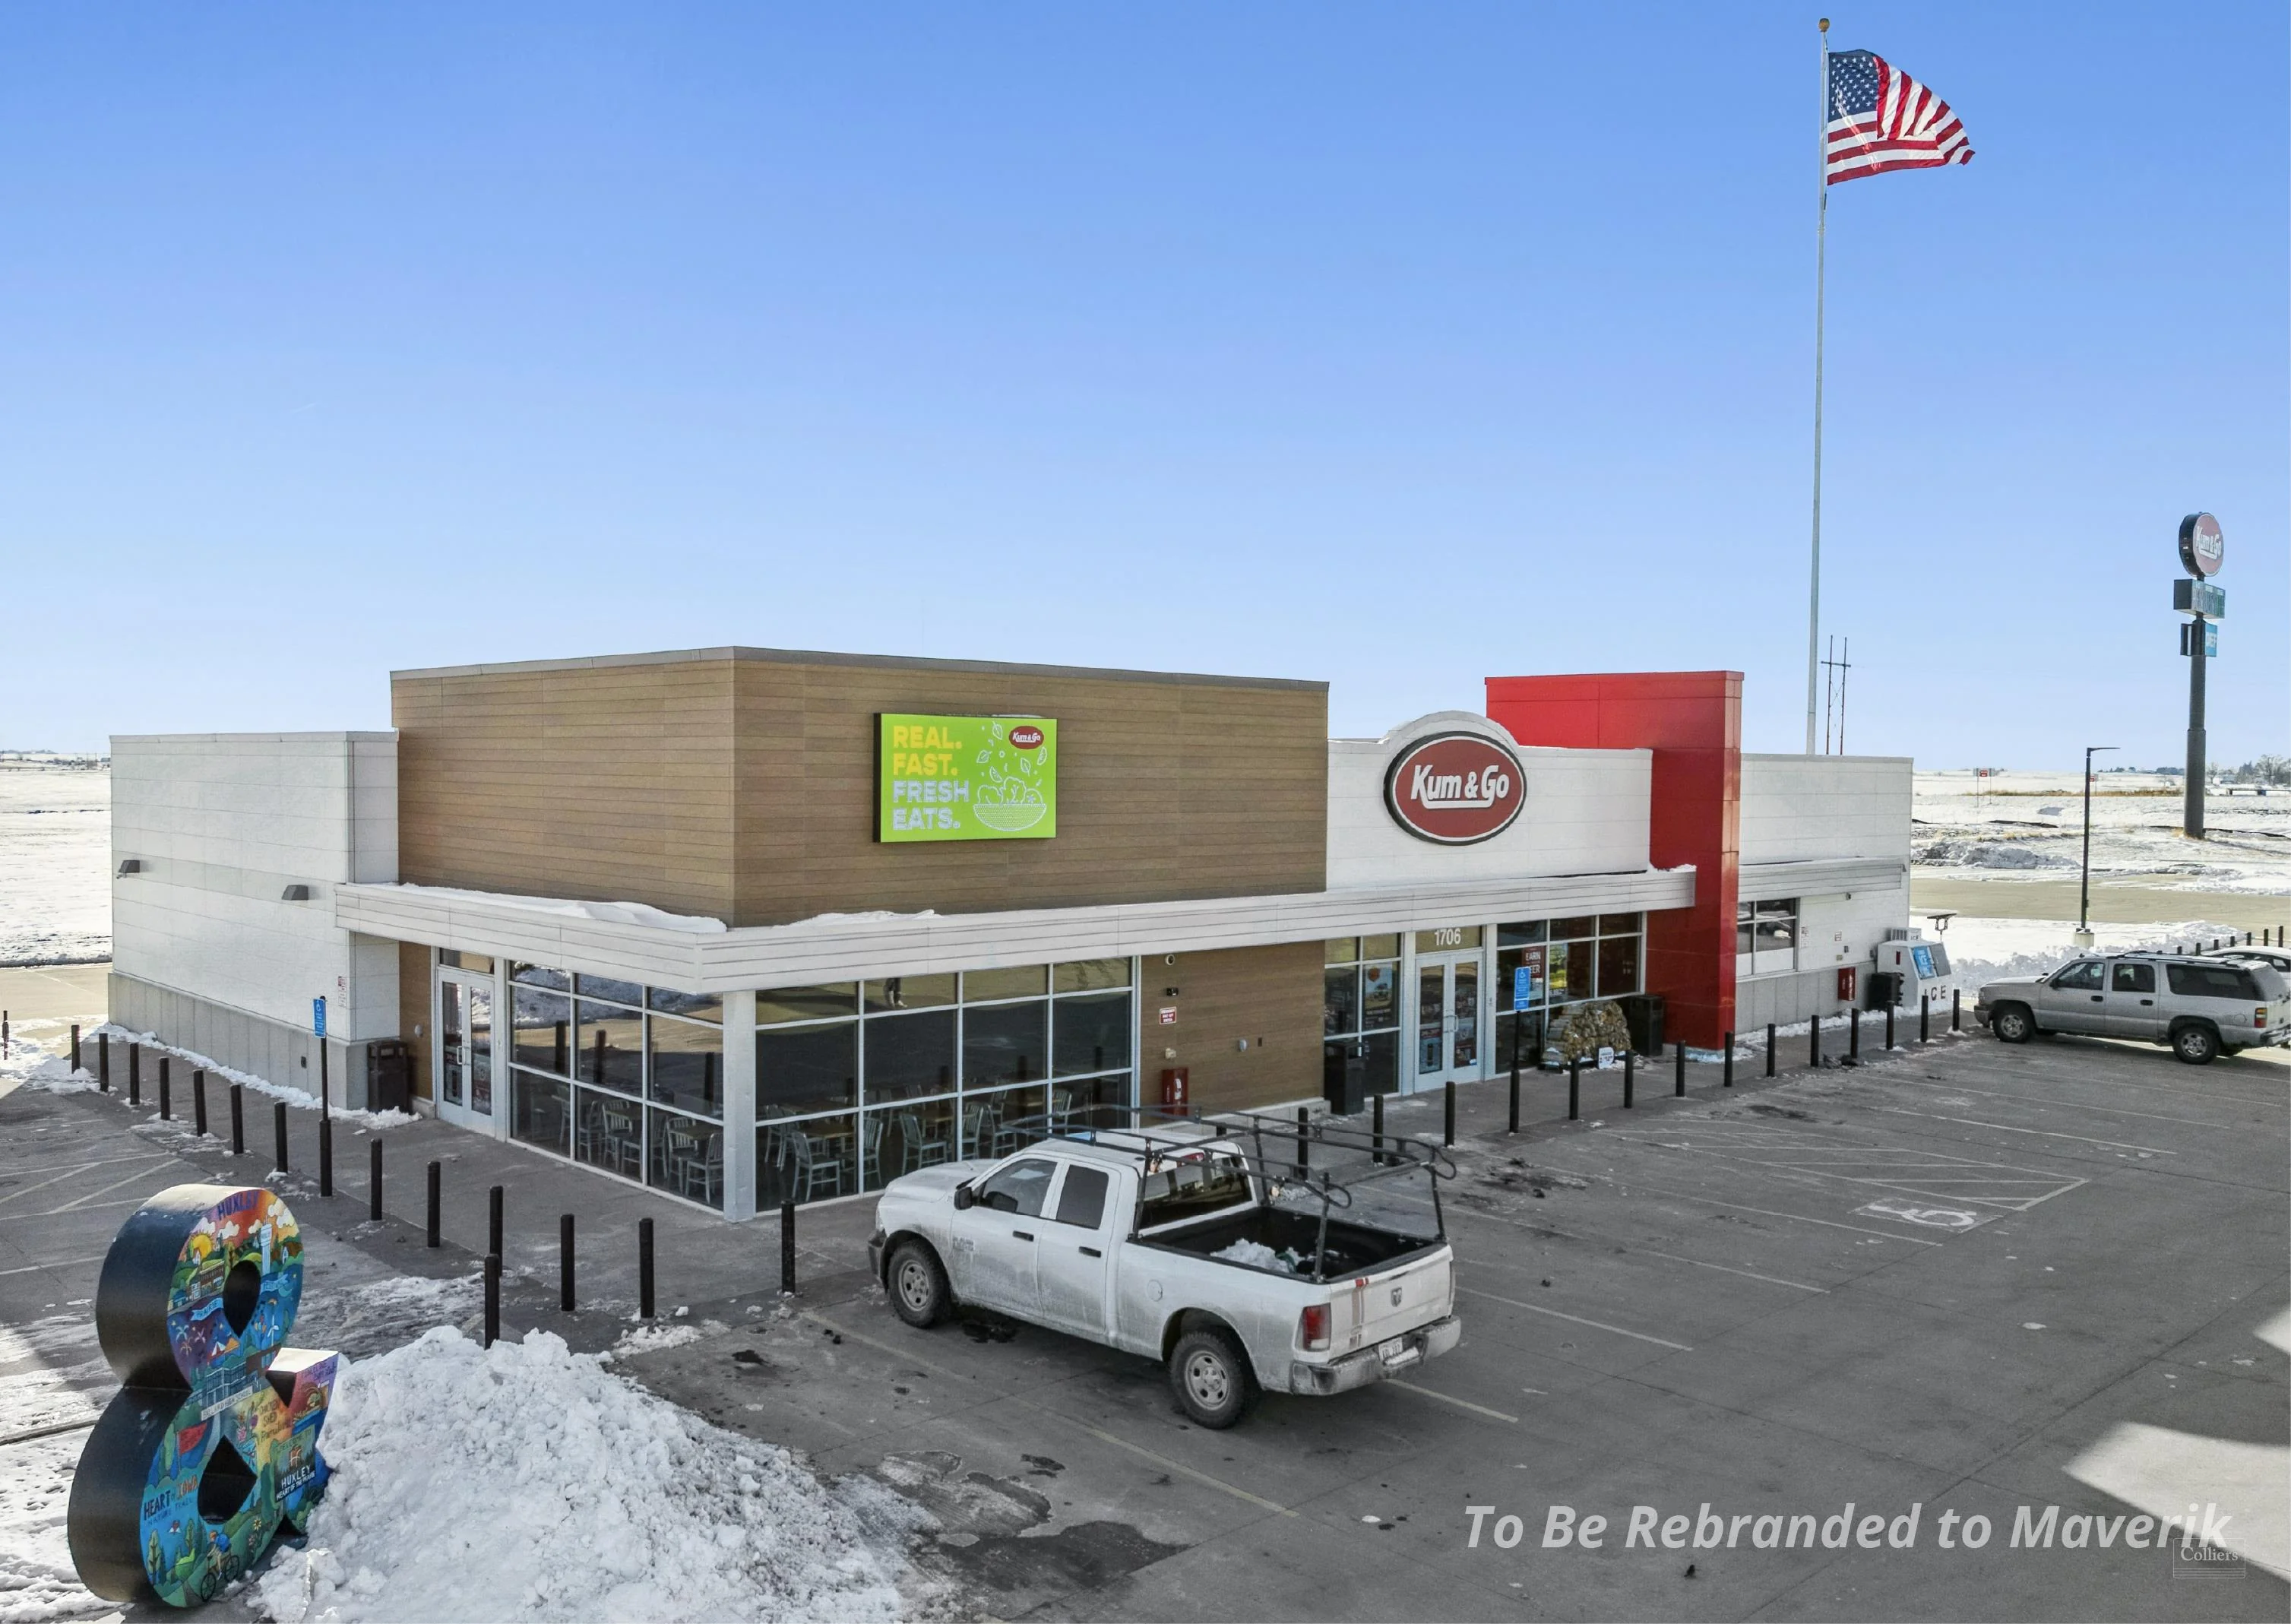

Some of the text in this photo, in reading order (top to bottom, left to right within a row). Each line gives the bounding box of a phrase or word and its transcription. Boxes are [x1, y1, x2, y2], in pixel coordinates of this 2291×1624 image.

[893, 726, 962, 749] REAL.
[893, 753, 957, 776] FAST.
[893, 780, 969, 803] FRESH
[893, 807, 960, 831] EATS.
[1434, 927, 1461, 946] 1706
[217, 1190, 259, 1221] HUXLEY
[281, 1465, 311, 1489] HUXLEY
[144, 1489, 171, 1521] HEART
